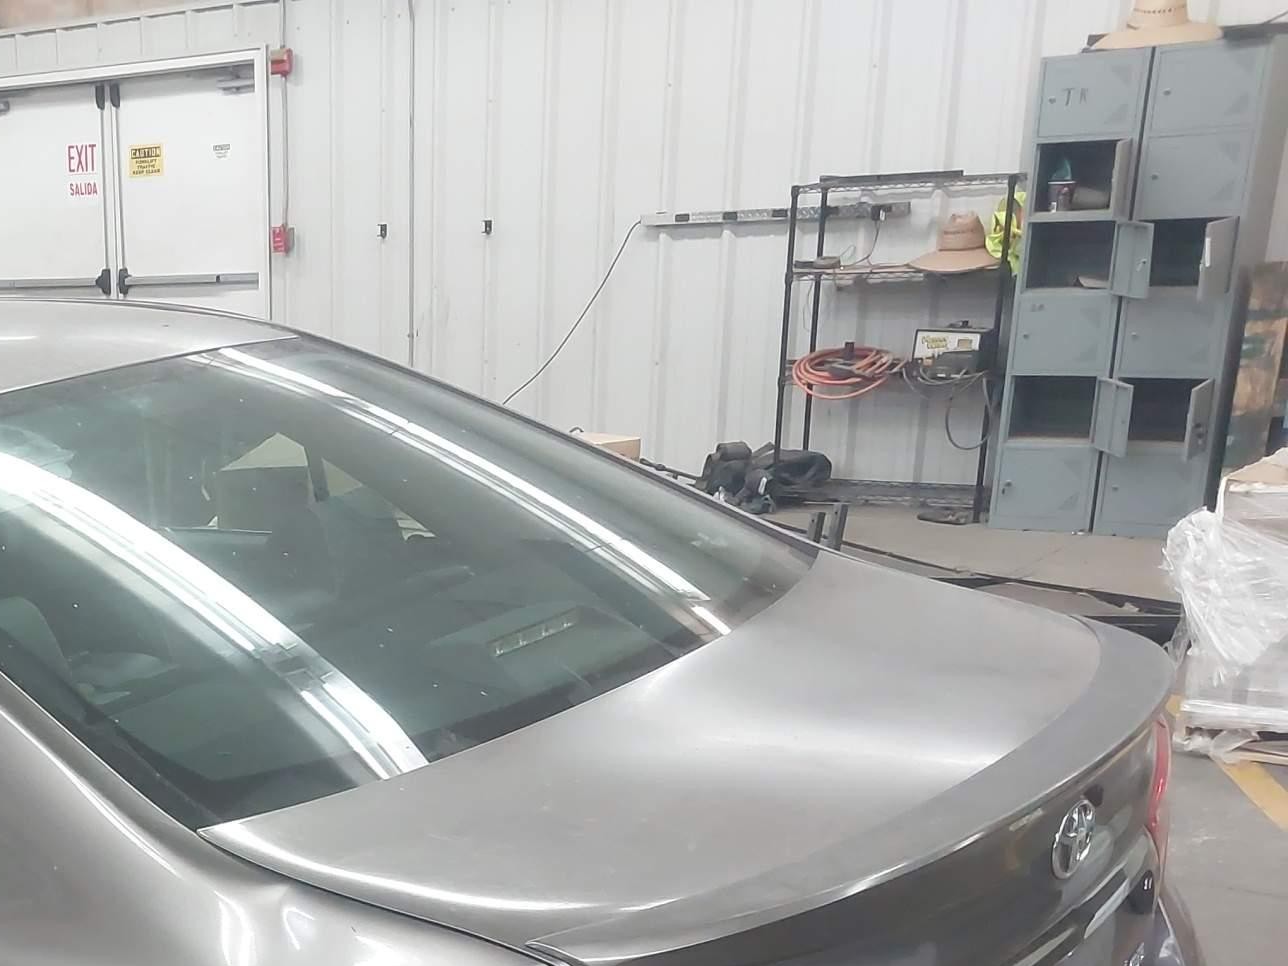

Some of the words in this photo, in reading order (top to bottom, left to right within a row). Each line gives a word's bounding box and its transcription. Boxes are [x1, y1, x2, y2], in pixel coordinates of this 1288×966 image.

[67, 143, 97, 173] EXIT
[131, 147, 160, 159] CAUTION
[69, 181, 98, 196] SALIDA
